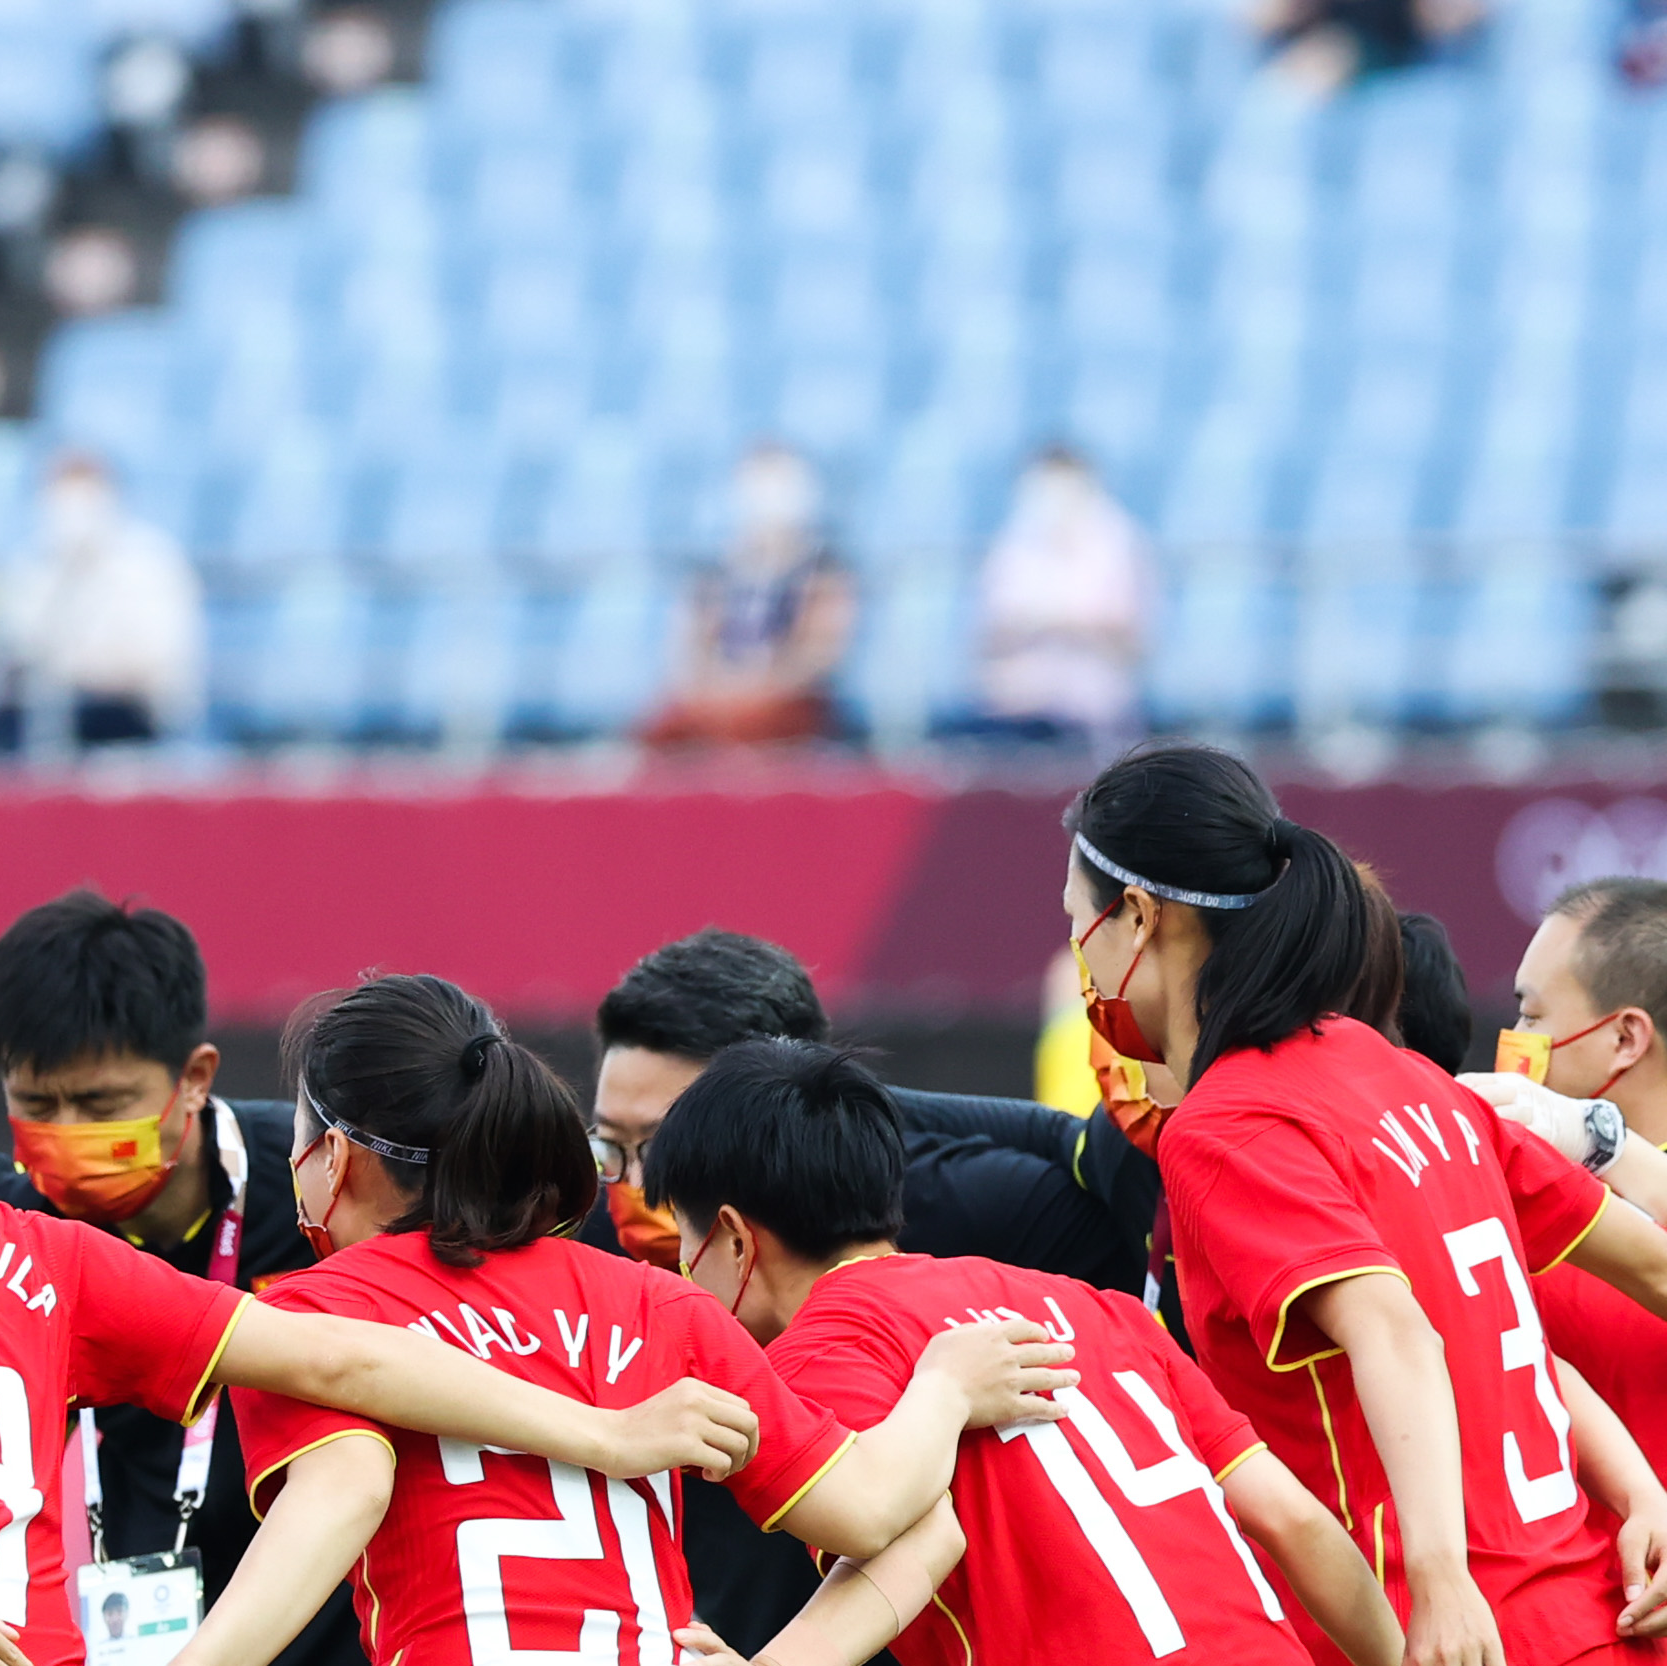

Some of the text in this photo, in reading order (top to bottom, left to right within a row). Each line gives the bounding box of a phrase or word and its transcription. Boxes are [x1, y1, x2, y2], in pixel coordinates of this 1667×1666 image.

[332, 1119, 354, 1138] NIKE
[370, 1140, 395, 1155] NIKE
[1443, 1217, 1579, 1524] 3
[992, 1369, 1286, 1659] 14
